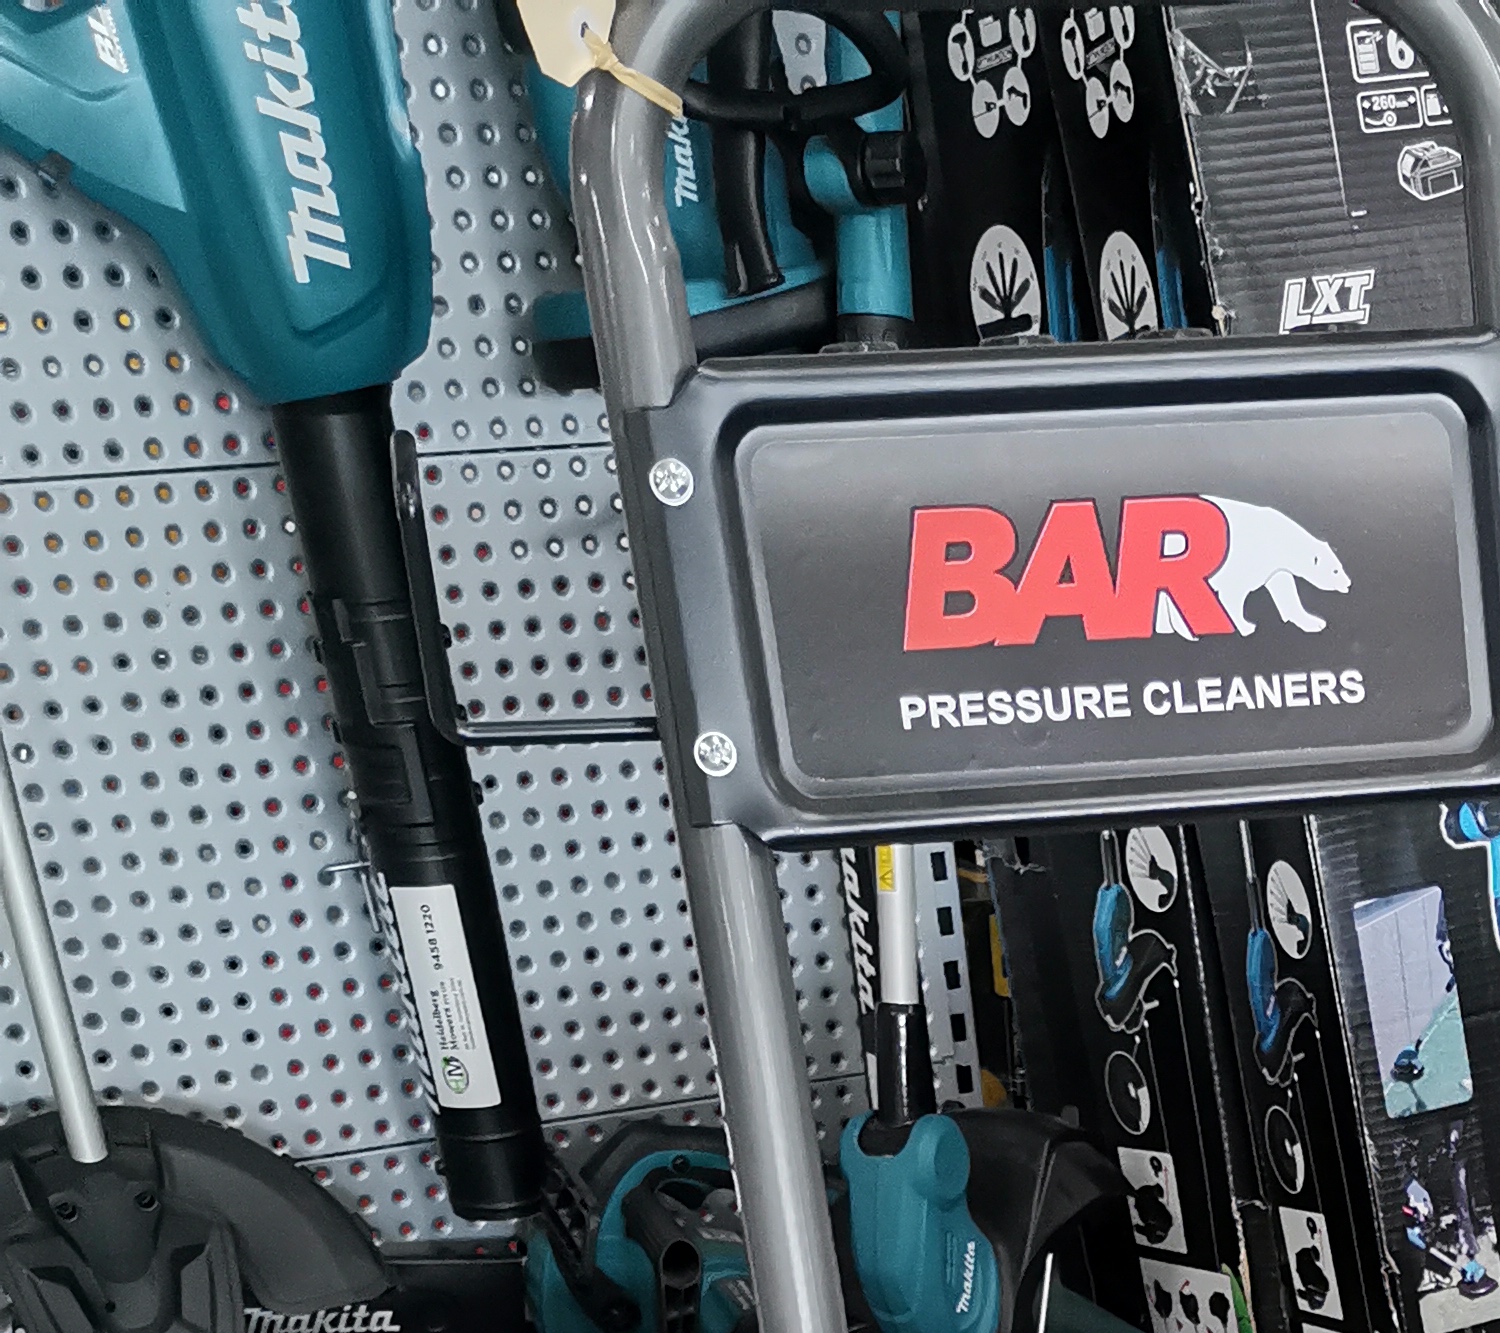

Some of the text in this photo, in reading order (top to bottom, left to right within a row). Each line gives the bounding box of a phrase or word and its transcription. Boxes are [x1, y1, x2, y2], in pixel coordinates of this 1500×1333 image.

[236, 0, 351, 283] makit
[664, 117, 699, 208] mak
[1279, 269, 1375, 335] LXT
[903, 494, 1236, 653] BAR
[900, 670, 1366, 730] PRESSURE CLEANERS
[418, 903, 443, 969] 9458 1220
